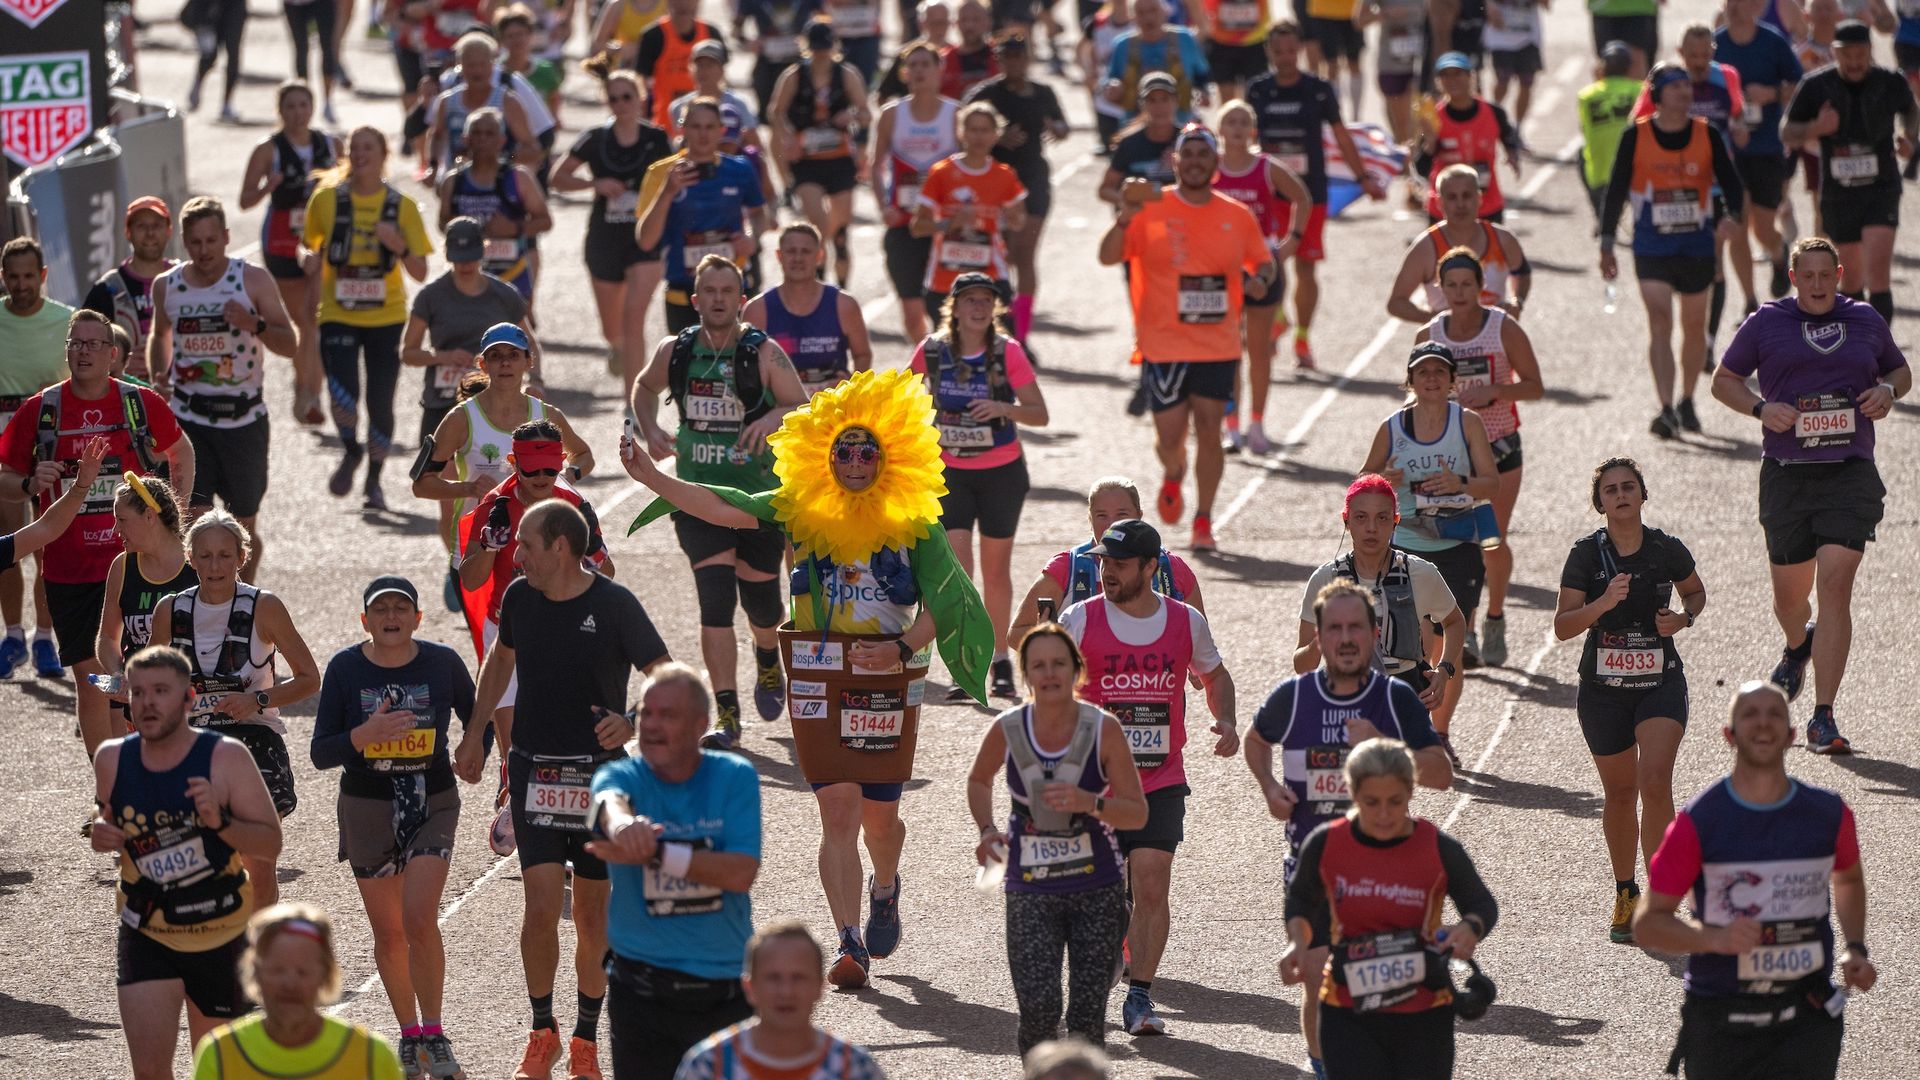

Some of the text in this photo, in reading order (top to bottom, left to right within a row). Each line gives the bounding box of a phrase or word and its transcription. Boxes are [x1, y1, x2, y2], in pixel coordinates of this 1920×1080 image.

[0, 63, 79, 99] TAG
[0, 107, 84, 163] EUER
[180, 303, 222, 315] DAZ
[184, 335, 225, 352] 46826
[693, 401, 736, 416] 11511
[1803, 414, 1848, 432] 50946
[943, 428, 985, 442] 13943
[692, 442, 725, 464] JOFF
[1407, 454, 1457, 473] RUTH
[1103, 653, 1175, 674] JACK
[1604, 652, 1655, 671] 44933
[1101, 671, 1175, 690] COSMIC
[1635, 680, 1657, 688] balance
[850, 715, 896, 732] 51444
[1322, 727, 1340, 743] UK
[1312, 751, 1338, 767] tcs
[535, 789, 590, 809] 36178
[1031, 841, 1081, 860] 16593
[144, 848, 198, 878] 18492
[1752, 951, 1812, 972] 18408
[1357, 960, 1415, 988] 17965
